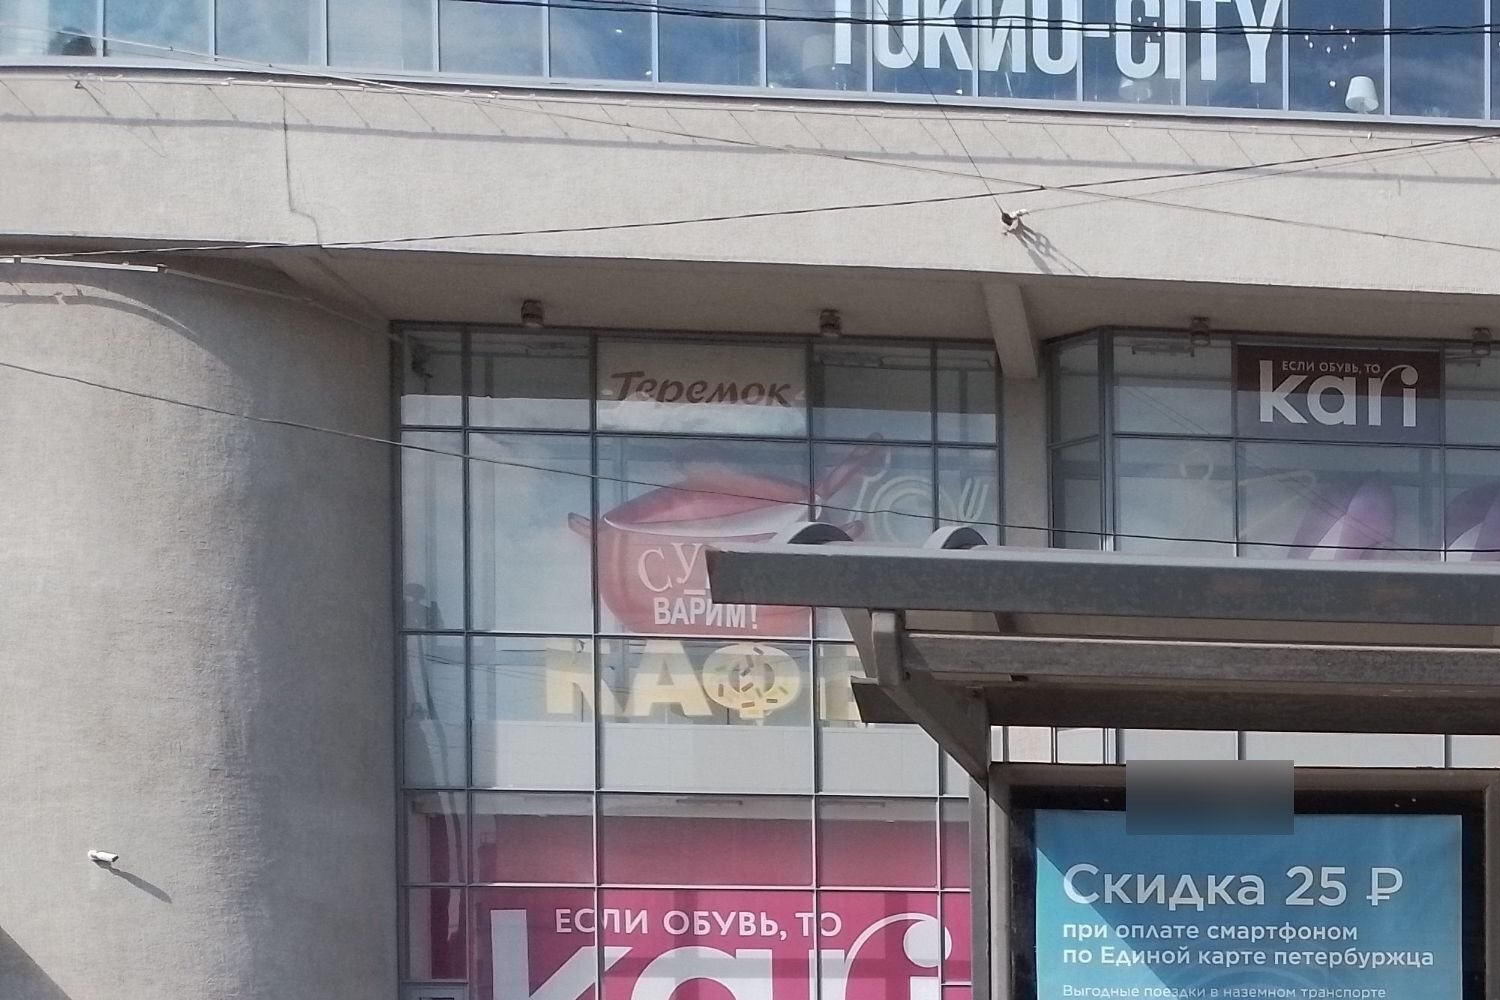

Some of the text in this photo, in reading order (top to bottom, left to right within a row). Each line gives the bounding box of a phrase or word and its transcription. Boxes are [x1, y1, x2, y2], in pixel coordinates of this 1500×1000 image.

[1282, 360, 1381, 374] ЕСЛИ ОБУВЬ, ТО
[610, 370, 792, 407] Теремок
[1259, 359, 1419, 427] kari
[638, 542, 711, 592] СУ
[654, 597, 758, 630] ВАРИМ!
[1063, 863, 1266, 912] Скидка
[1285, 866, 1348, 906] 25
[555, 908, 843, 942] ЕСЛИ ОБУВЬ, ТО
[1063, 920, 1358, 945] при оплате смартфоном
[1063, 944, 1435, 970] по Единой карте петербуржца
[1063, 984, 1387, 1000] Выгодные поездки в наземном транспорте
